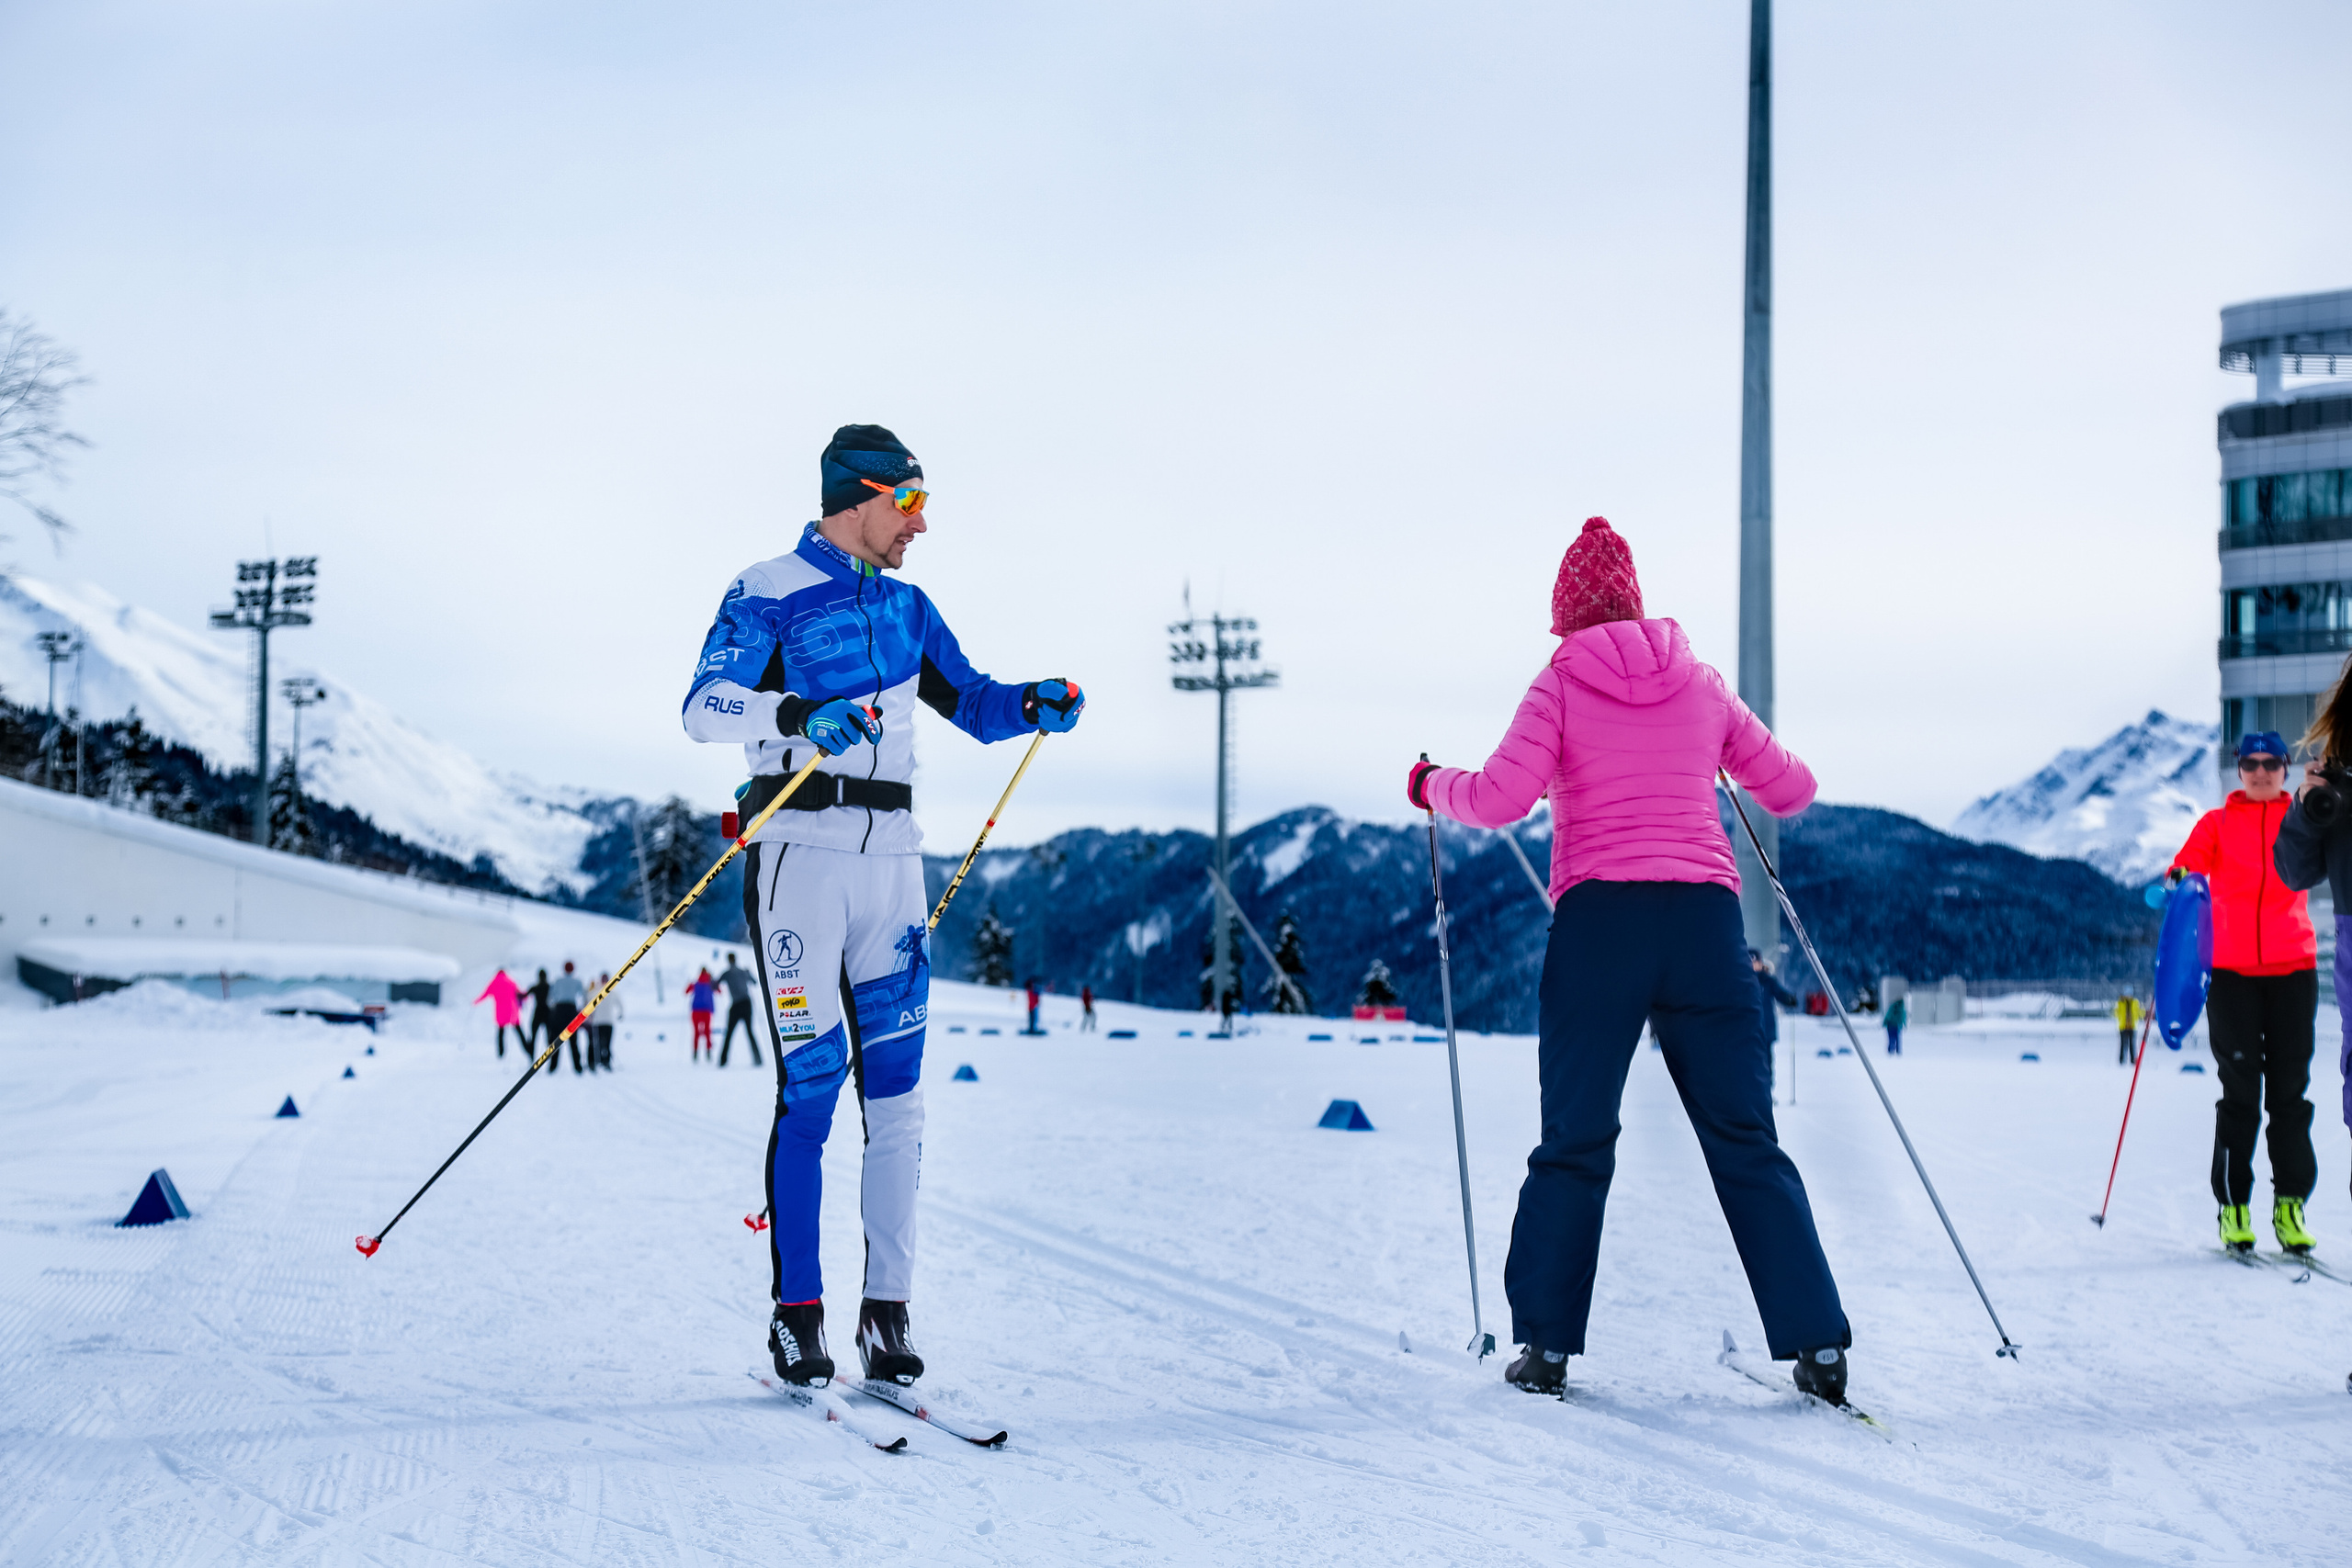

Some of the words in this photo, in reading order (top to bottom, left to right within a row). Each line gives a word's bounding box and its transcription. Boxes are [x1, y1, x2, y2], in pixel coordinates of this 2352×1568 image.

[705, 695, 745, 716] RUS
[775, 969, 799, 979] ABST
[781, 997, 800, 1008] TOKO
[899, 1002, 929, 1027] AB
